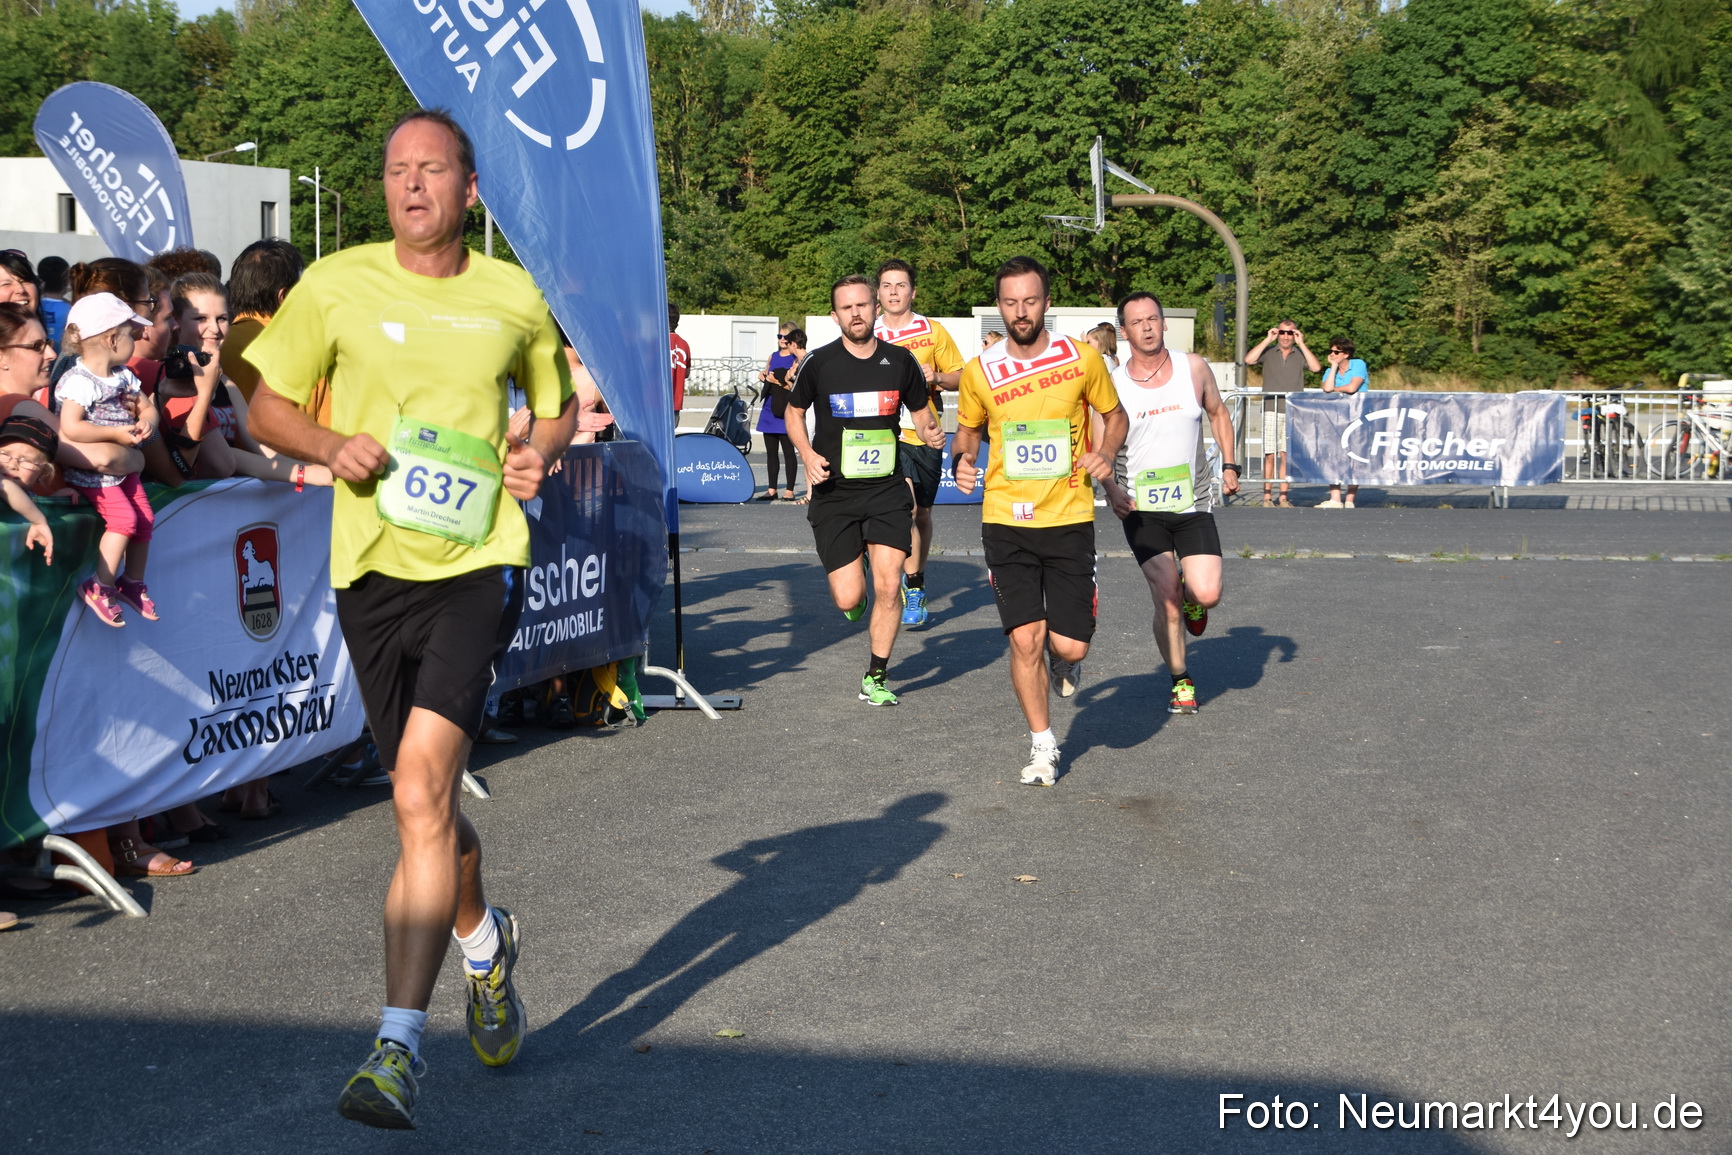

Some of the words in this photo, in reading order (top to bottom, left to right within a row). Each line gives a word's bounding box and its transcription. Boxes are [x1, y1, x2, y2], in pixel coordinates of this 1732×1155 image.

[993, 382, 1034, 406] MAX
[1038, 366, 1085, 390] BÖGL
[1016, 443, 1057, 464] 950
[1371, 431, 1506, 457] Fischer
[172, 451, 188, 473] SONY
[677, 462, 694, 473] und
[695, 460, 710, 470] das
[858, 449, 880, 464] 42
[1382, 460, 1494, 471] AUTOMOBILE
[404, 465, 478, 511] 637
[1148, 485, 1182, 504] 574
[406, 504, 430, 517] Martin
[430, 511, 461, 526] Drechsel
[251, 613, 273, 630] 1628
[507, 607, 604, 653] AUTOMOBILE
